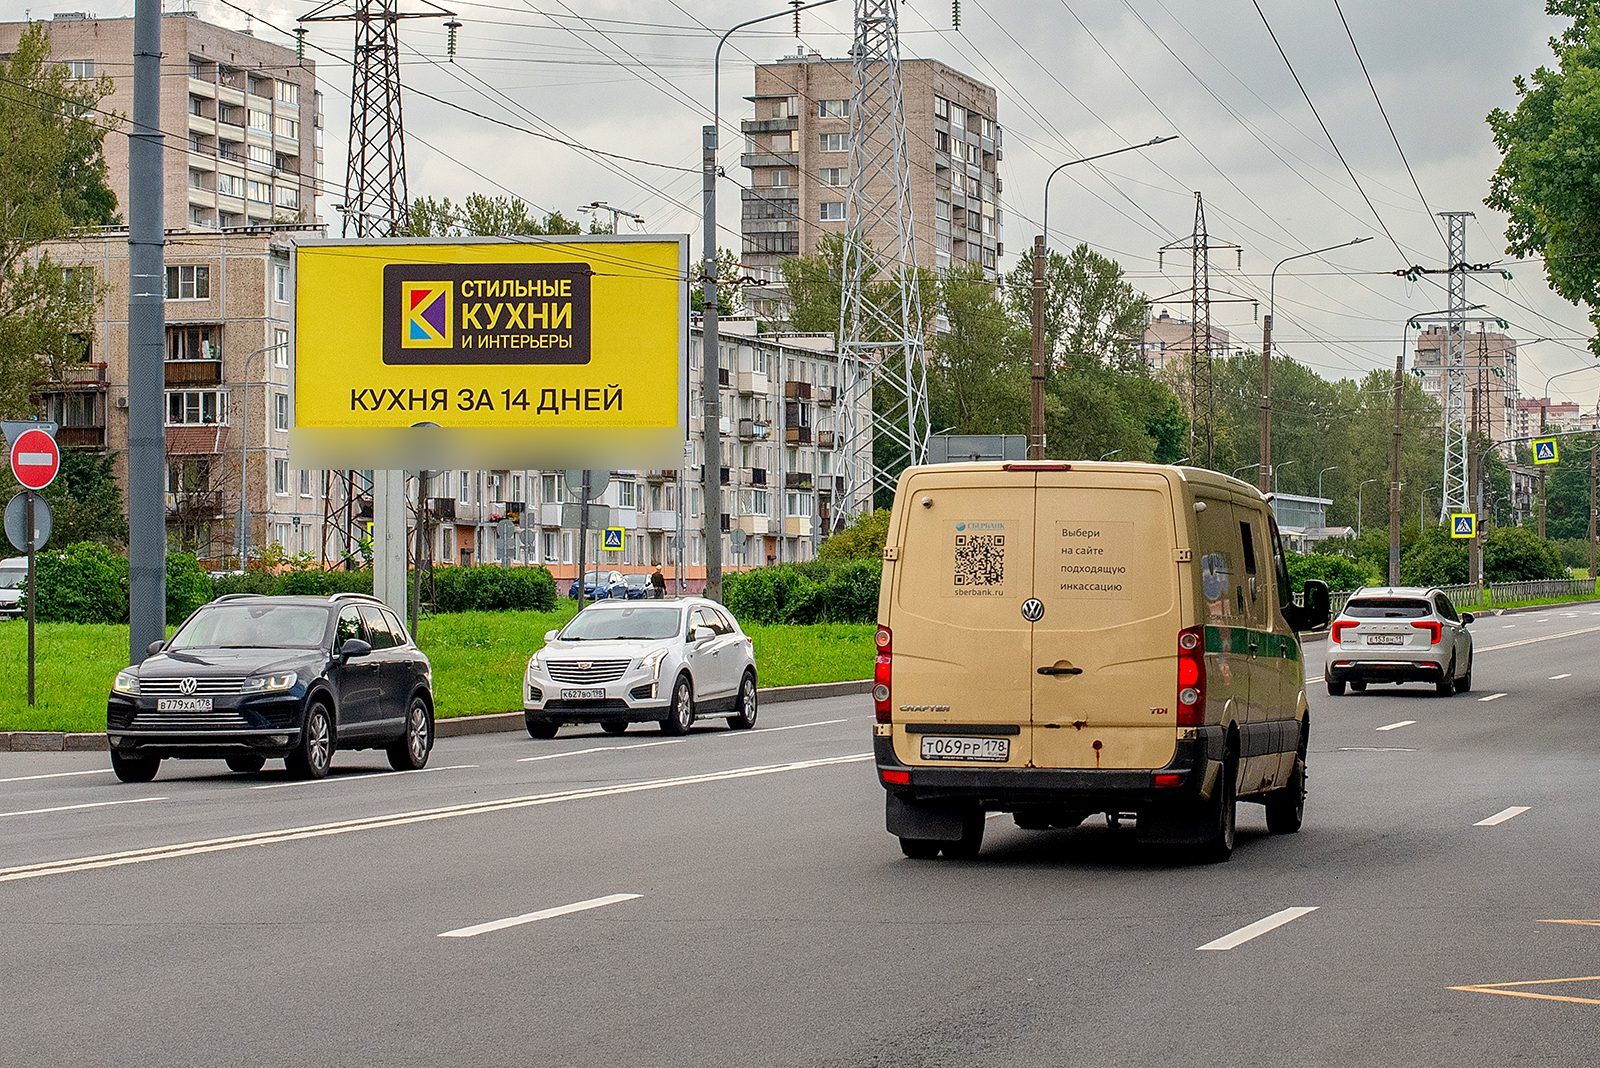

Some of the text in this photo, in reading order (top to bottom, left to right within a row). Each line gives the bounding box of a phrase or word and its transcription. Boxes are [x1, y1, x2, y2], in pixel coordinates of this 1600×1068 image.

[461, 279, 572, 297] СТИЛЬНЫЕ
[461, 302, 572, 330] КУХНИ
[461, 334, 572, 349] И ИНТЕРЬЕРЫ
[351, 384, 623, 415] КУХНЯ ЗА 14 ДНЕЙ
[1061, 528, 1100, 538] Выбери
[1075, 546, 1104, 555] сайте
[1060, 564, 1126, 575] подходящую
[954, 588, 1004, 596] sberbank.ru
[1060, 582, 1122, 592] инкассацию
[1150, 706, 1168, 715] TDI
[984, 740, 1005, 752] 178
